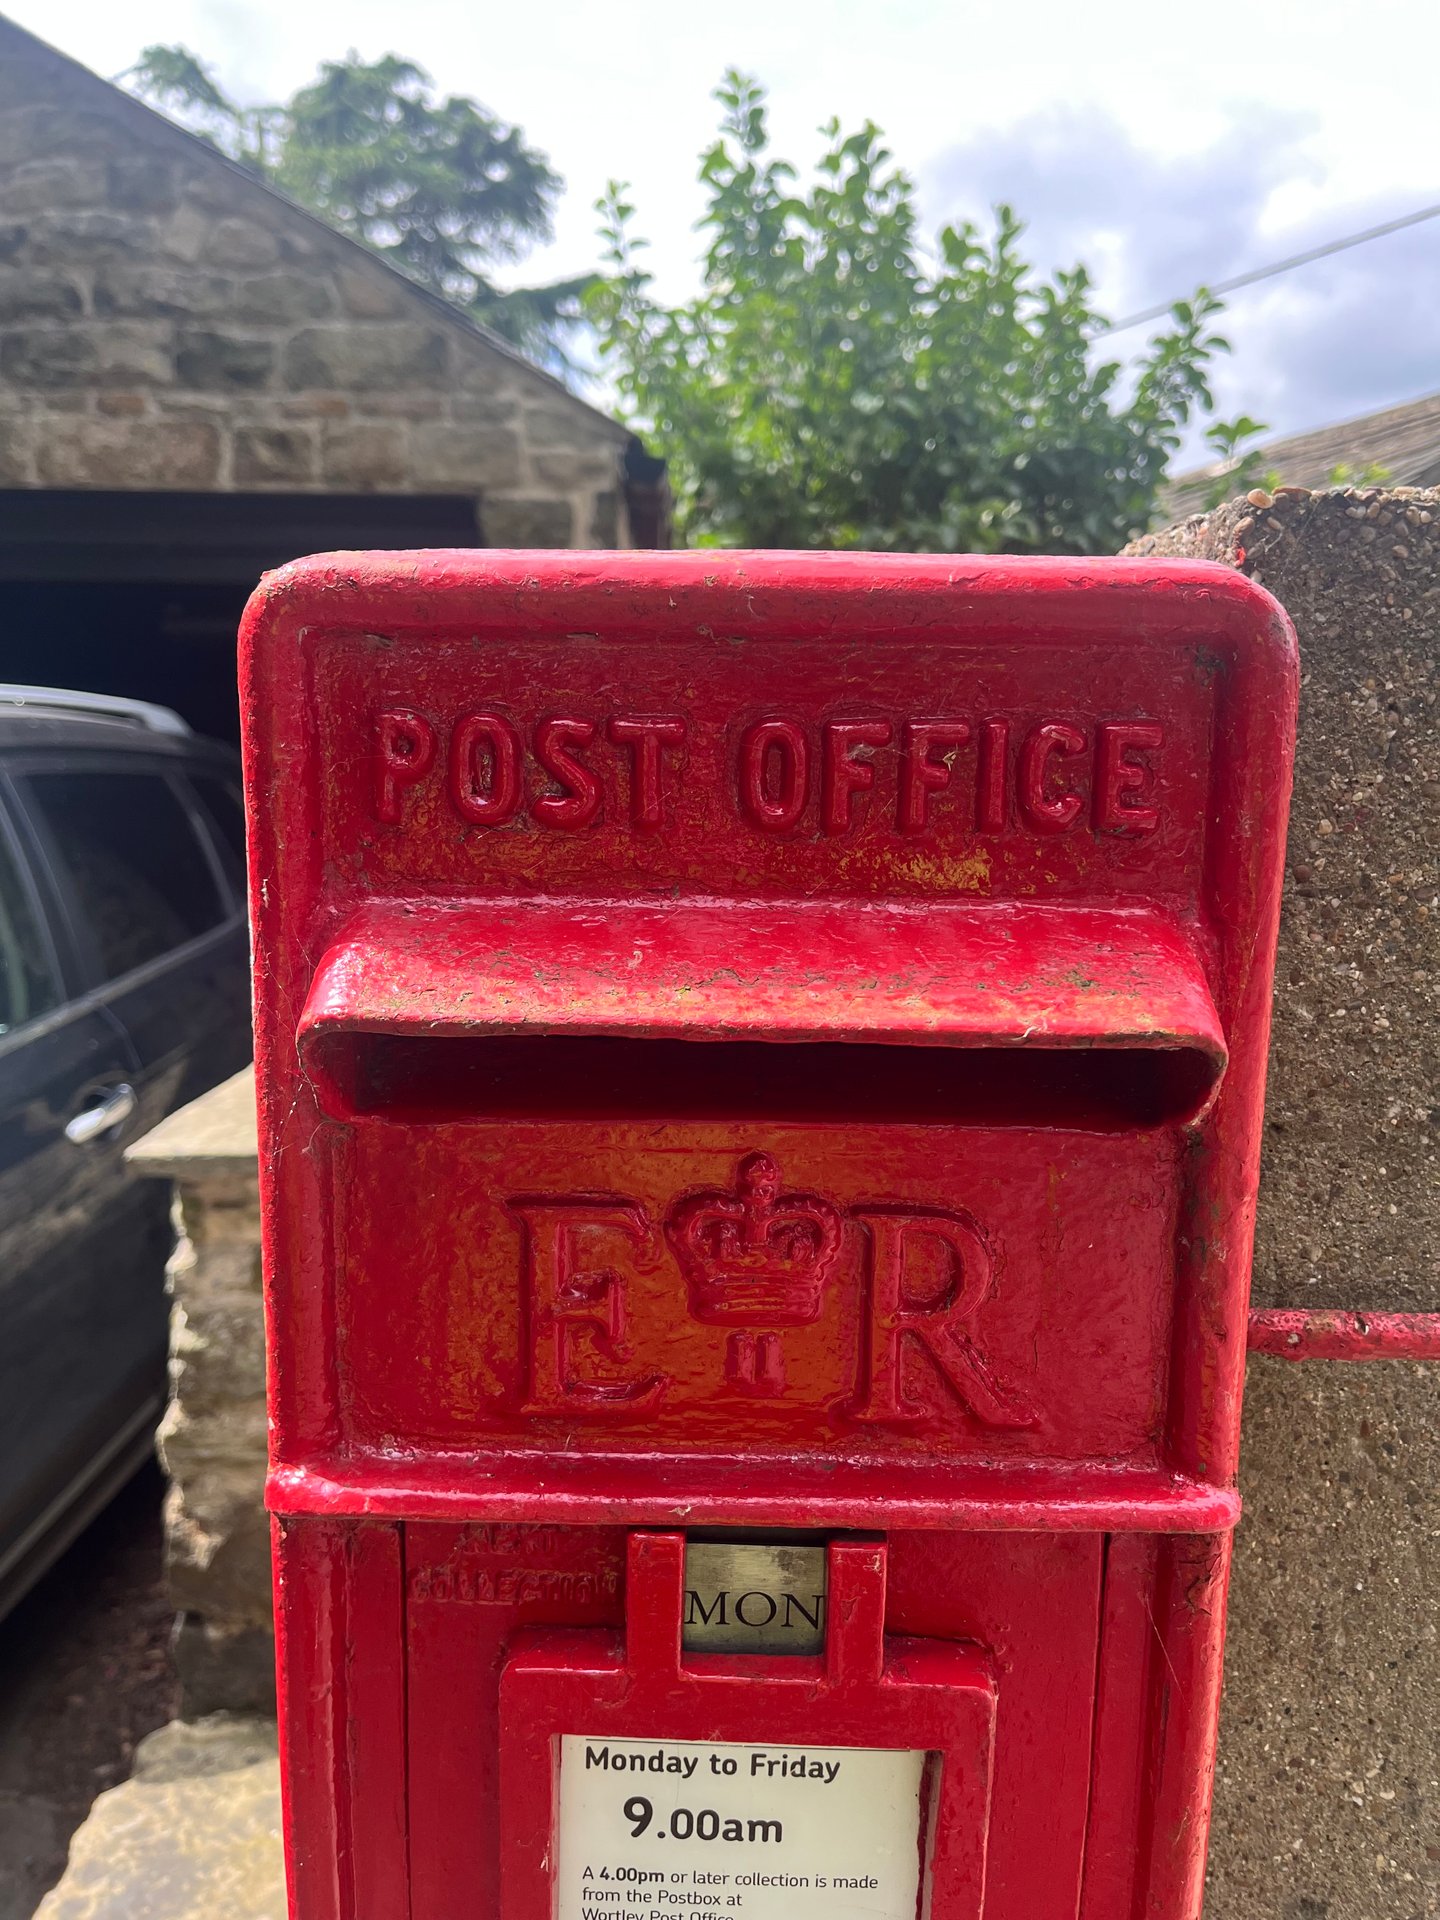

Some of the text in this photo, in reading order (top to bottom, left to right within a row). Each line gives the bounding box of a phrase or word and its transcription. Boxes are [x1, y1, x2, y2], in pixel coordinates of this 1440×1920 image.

[373, 707, 1165, 836] POST OFFICE
[506, 1194, 1040, 1425] E R
[684, 1590, 825, 1630] MON
[585, 1746, 841, 1784] Monday to Friday
[623, 1796, 783, 1842] 9.00am
[582, 1866, 879, 1890] A 4.00pm or later collection is made
[582, 1887, 743, 1906] from the Postbox at
[582, 1908, 644, 1920] Wortley
[651, 1910, 684, 1920] Post
